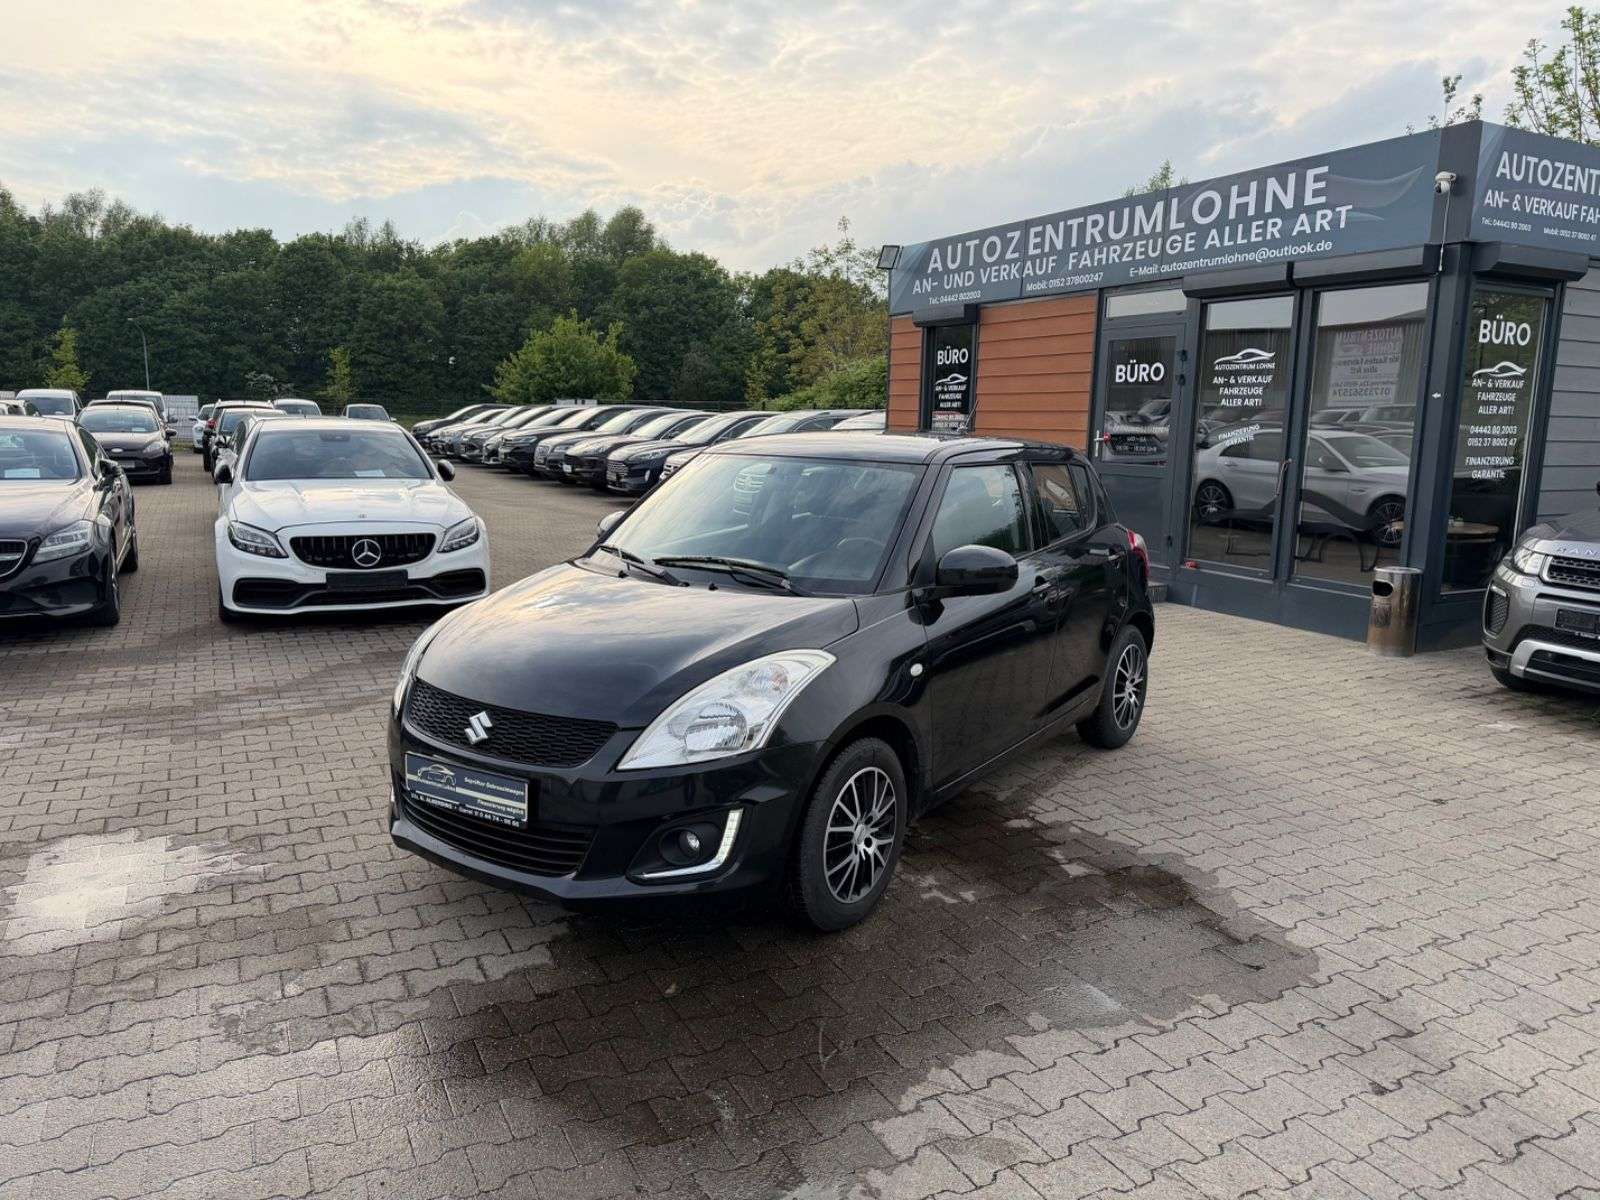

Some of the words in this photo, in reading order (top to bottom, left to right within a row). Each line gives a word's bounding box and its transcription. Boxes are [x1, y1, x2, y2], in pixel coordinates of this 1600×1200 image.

[1496, 151, 1600, 196] AUTOZENT
[1483, 189, 1509, 208] AN-
[1512, 194, 1521, 211] &
[1525, 196, 1579, 220] VERKAUF
[912, 276, 939, 295] AN-
[944, 270, 975, 290] UND
[980, 255, 1057, 285] VERKAUF
[1068, 232, 1197, 271] FAHRZEUGE
[1204, 217, 1281, 250] ALLER
[1291, 205, 1353, 236] ART
[1066, 272, 1104, 287] 37800247
[1479, 314, 1532, 346] BÜRO
[937, 346, 969, 365] BÜRO
[1115, 359, 1165, 382] BÜRO
[1212, 376, 1228, 384] AN-
[1237, 375, 1274, 384] VERKAUF
[1472, 378, 1486, 387] AN-
[1487, 379, 1493, 388] &
[1495, 379, 1525, 389] VERKAUF
[1219, 386, 1264, 396] FAHRZEUGE
[1220, 398, 1241, 407] ALLER
[1477, 392, 1517, 402] FAHRZEUGE
[1478, 406, 1498, 414] ALLER
[1470, 425, 1491, 434] 04442
[1465, 456, 1515, 466] FINANZIERUNG
